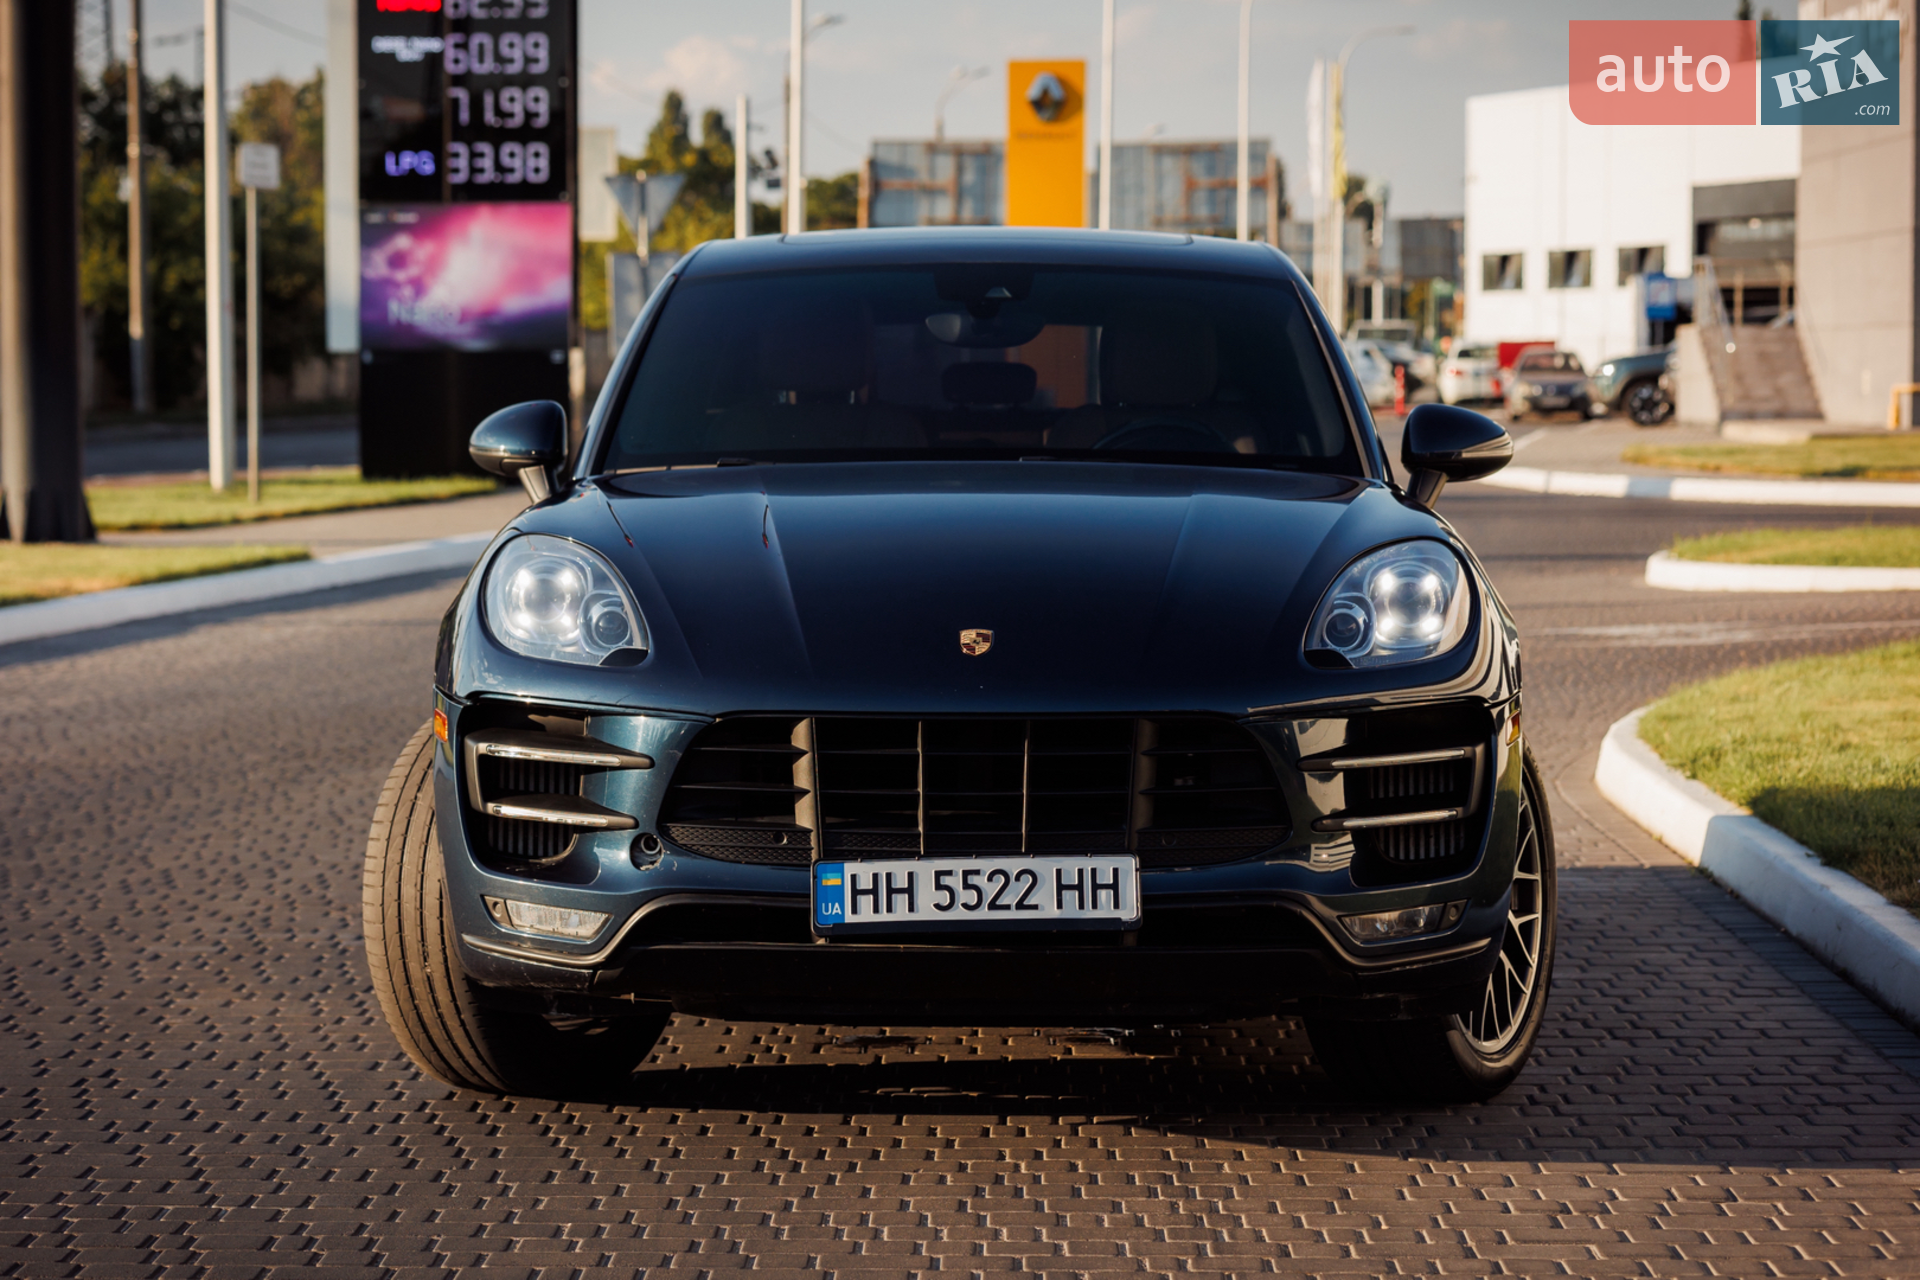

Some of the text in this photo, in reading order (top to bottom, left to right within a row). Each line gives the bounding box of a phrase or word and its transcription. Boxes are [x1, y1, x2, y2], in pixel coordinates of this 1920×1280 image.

[443, 31, 549, 75] 60.99
[446, 85, 549, 128] 71.99
[384, 141, 549, 184] LPG 33.98
[821, 902, 842, 915] UA
[850, 866, 1120, 915] HH 5522 HH
